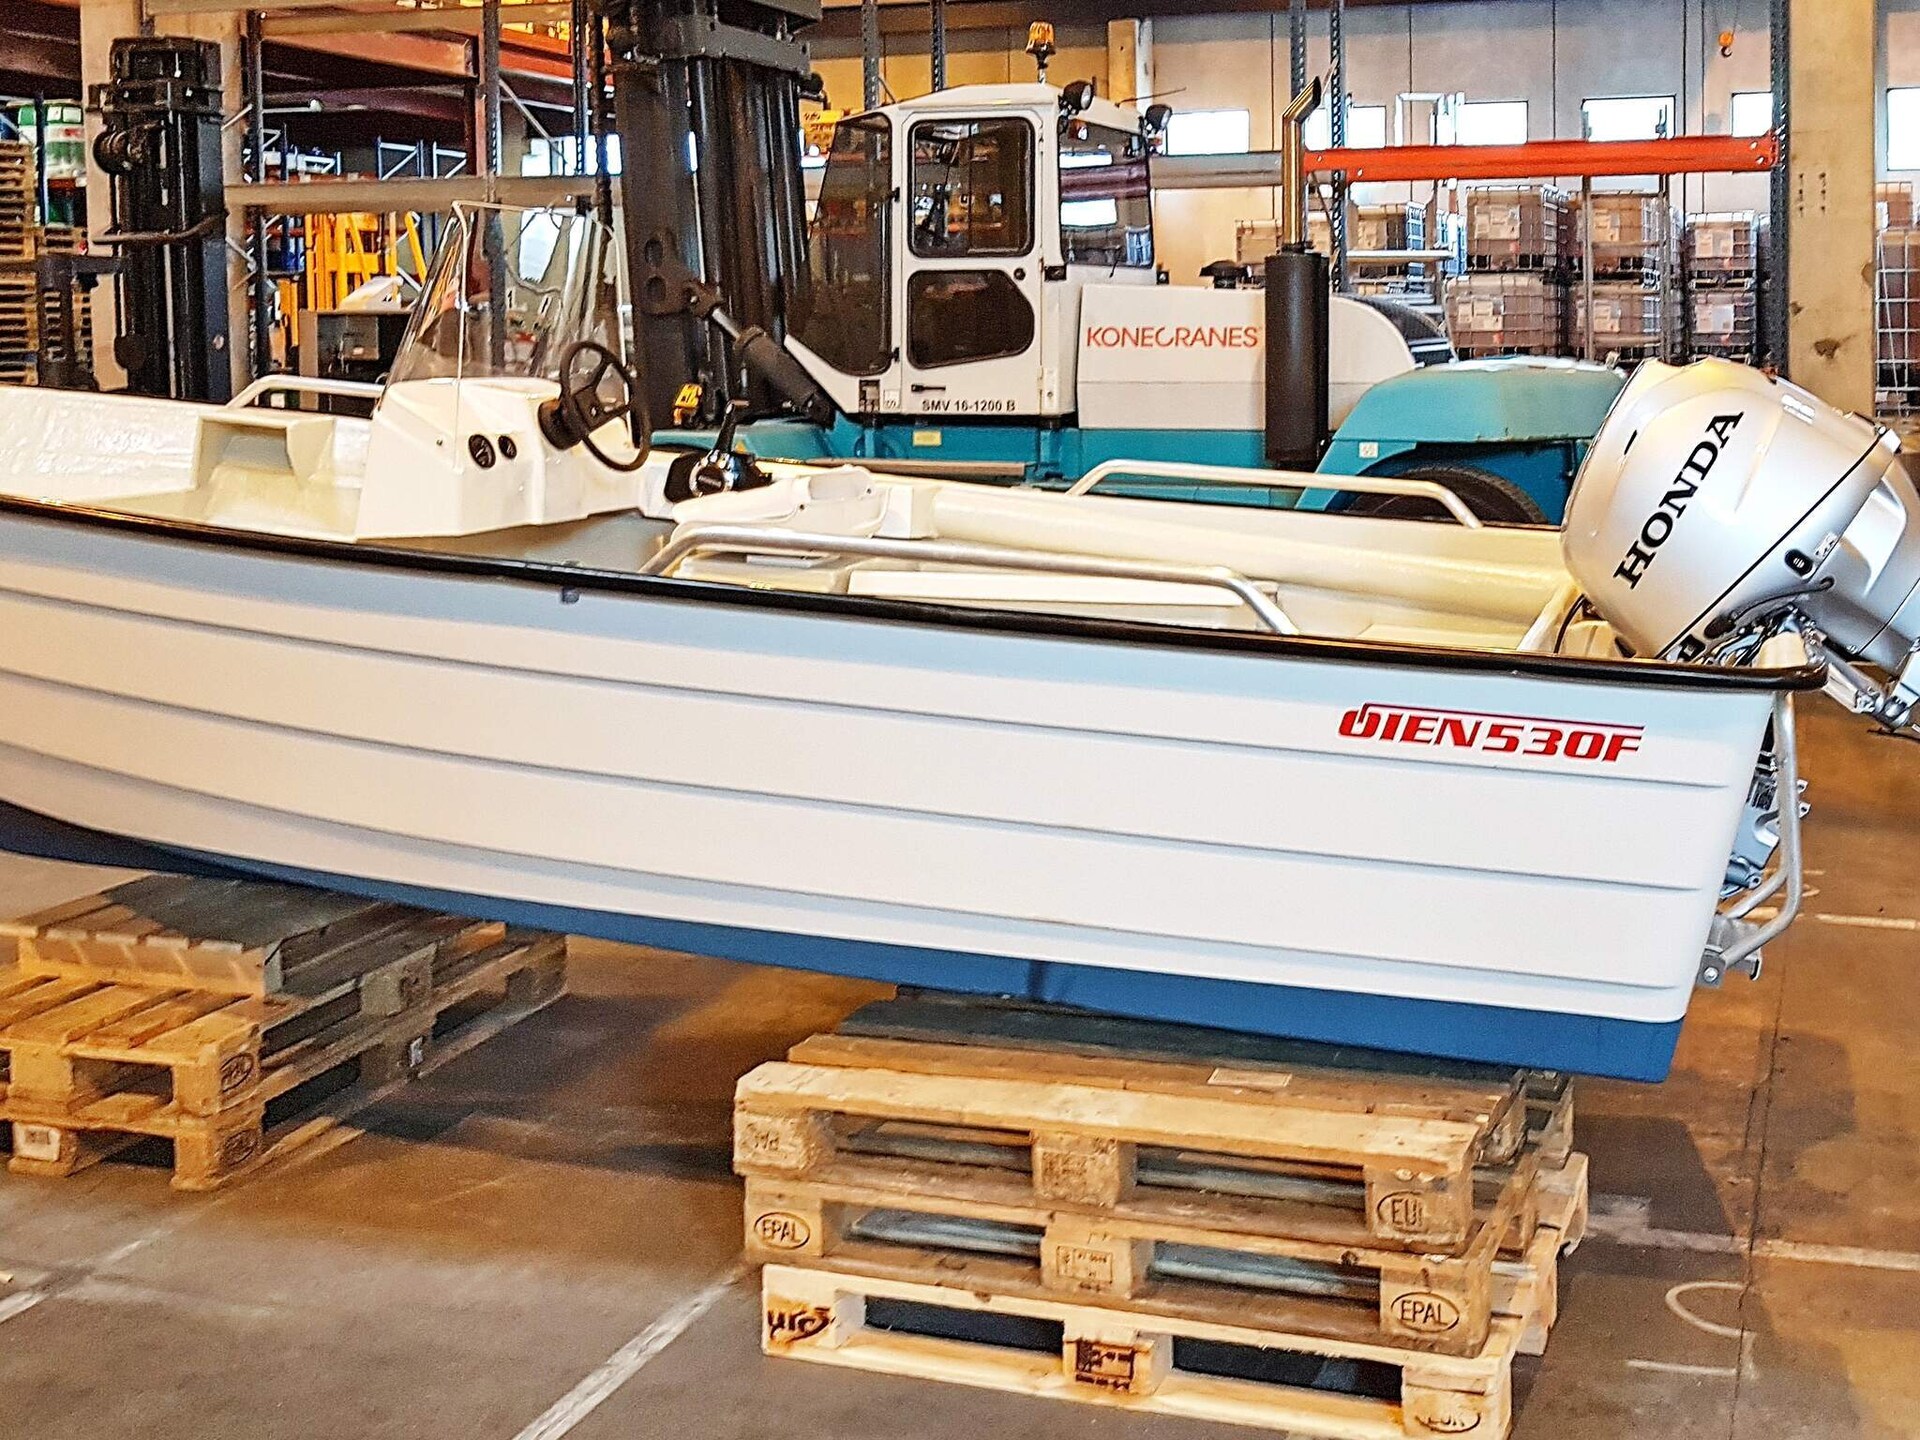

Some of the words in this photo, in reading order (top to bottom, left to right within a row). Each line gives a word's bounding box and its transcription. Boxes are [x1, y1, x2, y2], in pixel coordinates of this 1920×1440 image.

[1087, 326, 1258, 348] KONECRANES
[921, 399, 951, 412] SMV
[954, 399, 1002, 412] 16-1200
[1005, 399, 1016, 412] B
[1613, 411, 1744, 590] HONDA
[761, 1217, 803, 1244] EPAL
[1399, 1298, 1449, 1327] EPAL
